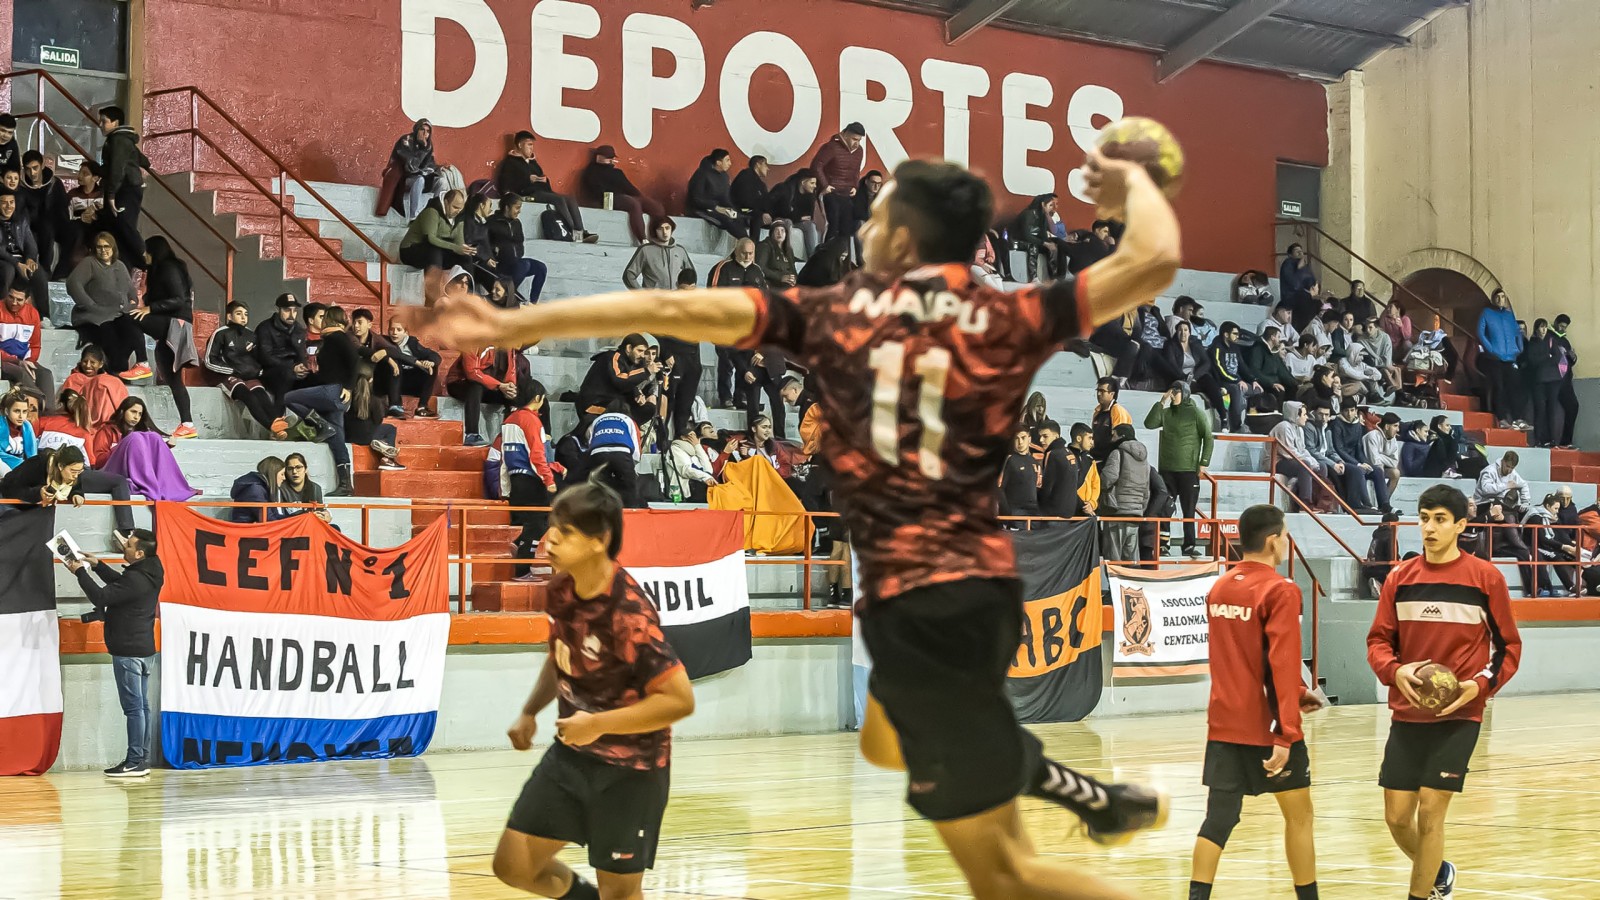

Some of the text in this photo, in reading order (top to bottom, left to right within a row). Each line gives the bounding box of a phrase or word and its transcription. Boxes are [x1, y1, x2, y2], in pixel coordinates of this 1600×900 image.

[43, 50, 77, 64] SALIDA
[401, 0, 1124, 205] DEPORTES
[869, 340, 951, 481] 11
[195, 528, 310, 591] CEF
[186, 630, 415, 694] HANDBALL
[1011, 595, 1088, 668] ABC
